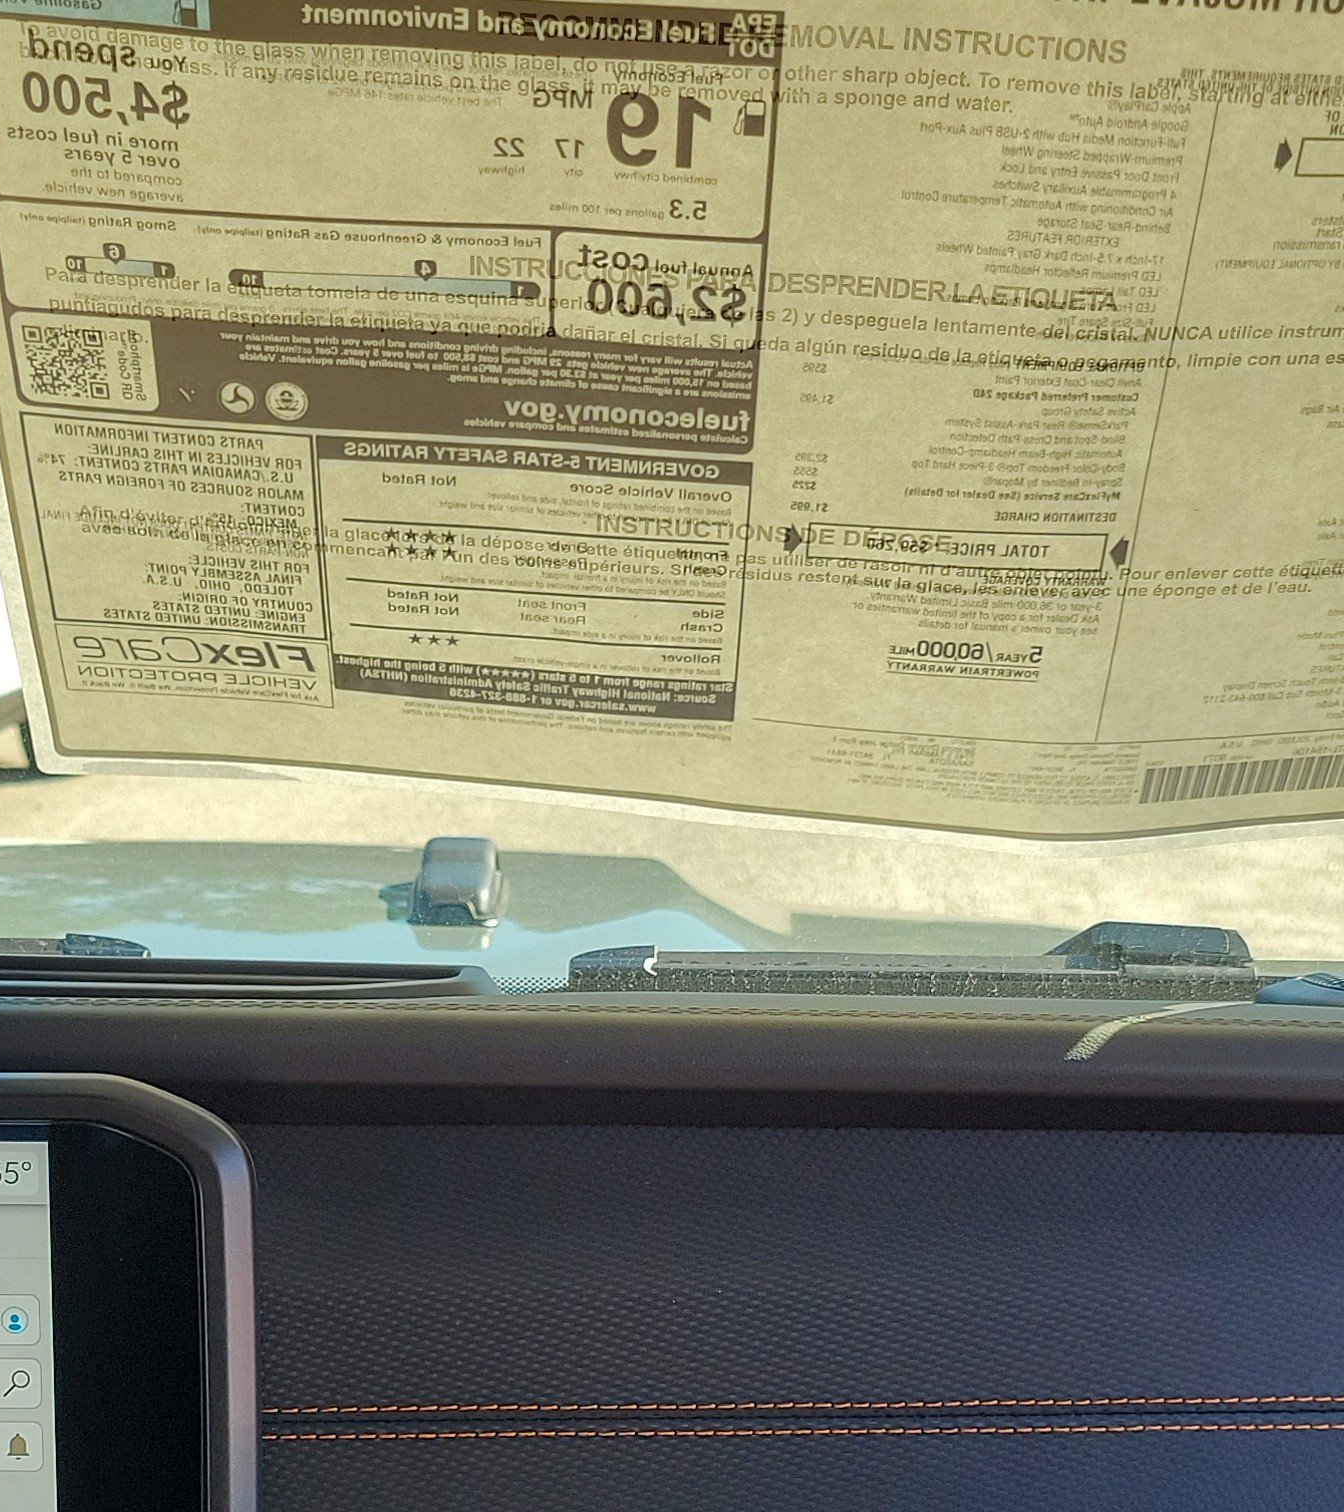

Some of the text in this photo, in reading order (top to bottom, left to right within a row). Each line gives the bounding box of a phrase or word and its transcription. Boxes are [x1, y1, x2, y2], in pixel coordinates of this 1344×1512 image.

[904, 27, 1127, 64] INSTRUCTIONS
[785, 66, 1122, 98] other sharp object. To remove this
[838, 90, 1013, 113] sponge and water.
[767, 272, 944, 303] DESPRENDER
[933, 316, 1036, 338] lentamente
[1218, 325, 1273, 340] utilice
[1187, 352, 1242, 367] limpie
[1248, 355, 1280, 366] con
[1287, 354, 1319, 366] una
[1119, 566, 1273, 581] Pour enlever cette
[1153, 580, 1311, 599] éponge l'eau.
